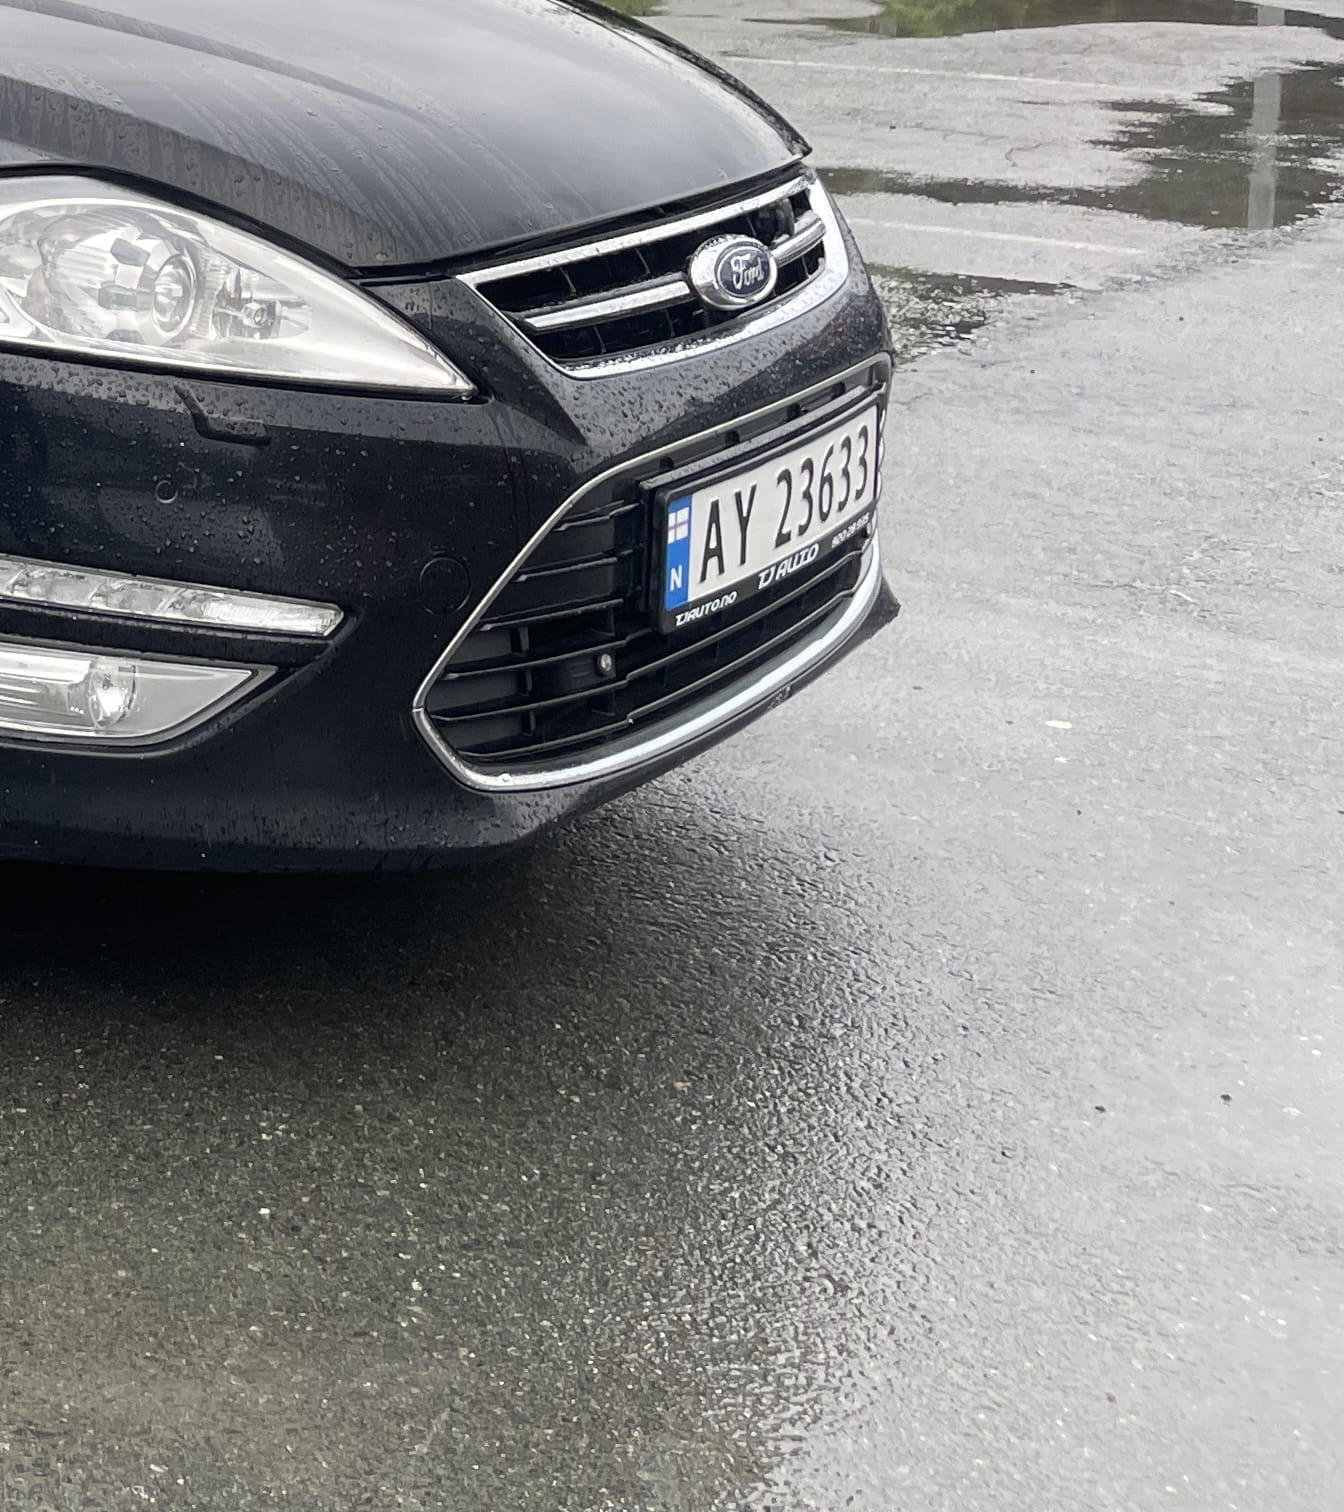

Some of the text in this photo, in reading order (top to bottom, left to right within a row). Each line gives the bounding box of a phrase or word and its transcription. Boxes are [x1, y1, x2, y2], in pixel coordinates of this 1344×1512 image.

[730, 253, 765, 290] Ford
[699, 424, 870, 584] AY 23633
[669, 565, 683, 592] N
